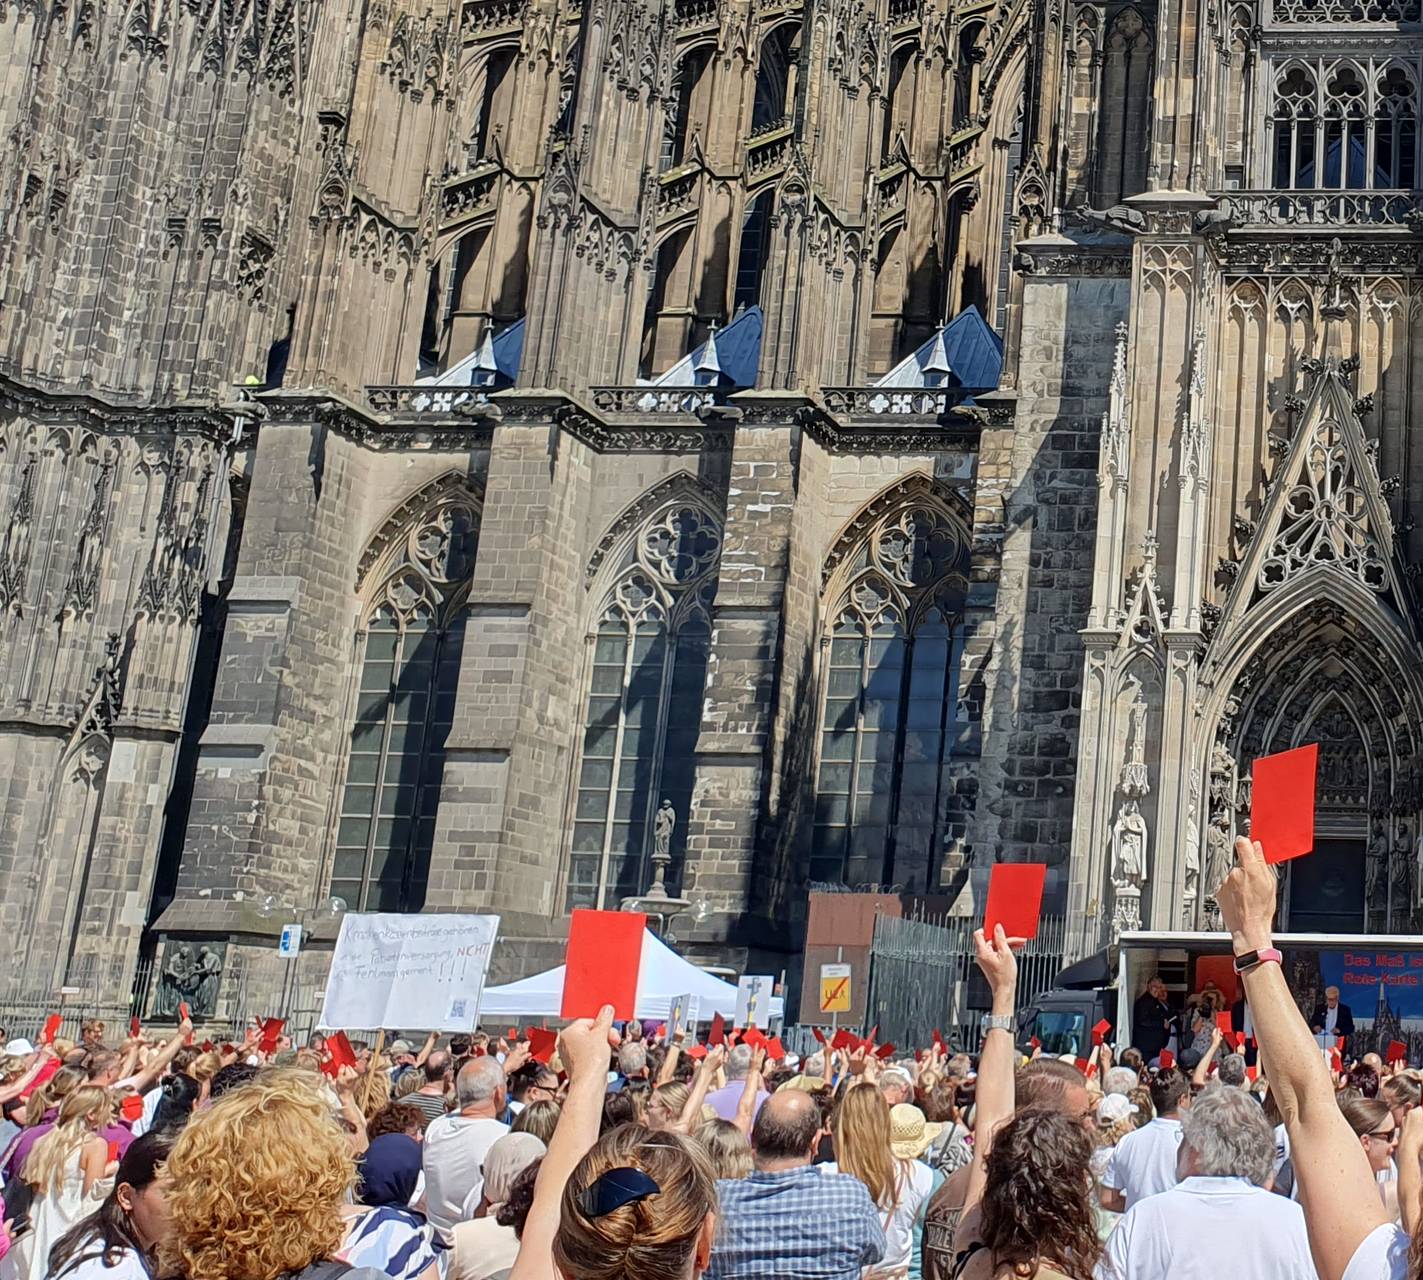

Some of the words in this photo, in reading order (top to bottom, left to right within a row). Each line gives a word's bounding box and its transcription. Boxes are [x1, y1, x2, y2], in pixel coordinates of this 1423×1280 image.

[1344, 953, 1371, 967] Das
[1375, 954, 1405, 968] Maß
[1344, 973, 1376, 985] Rote
[1381, 973, 1417, 985] Karte
